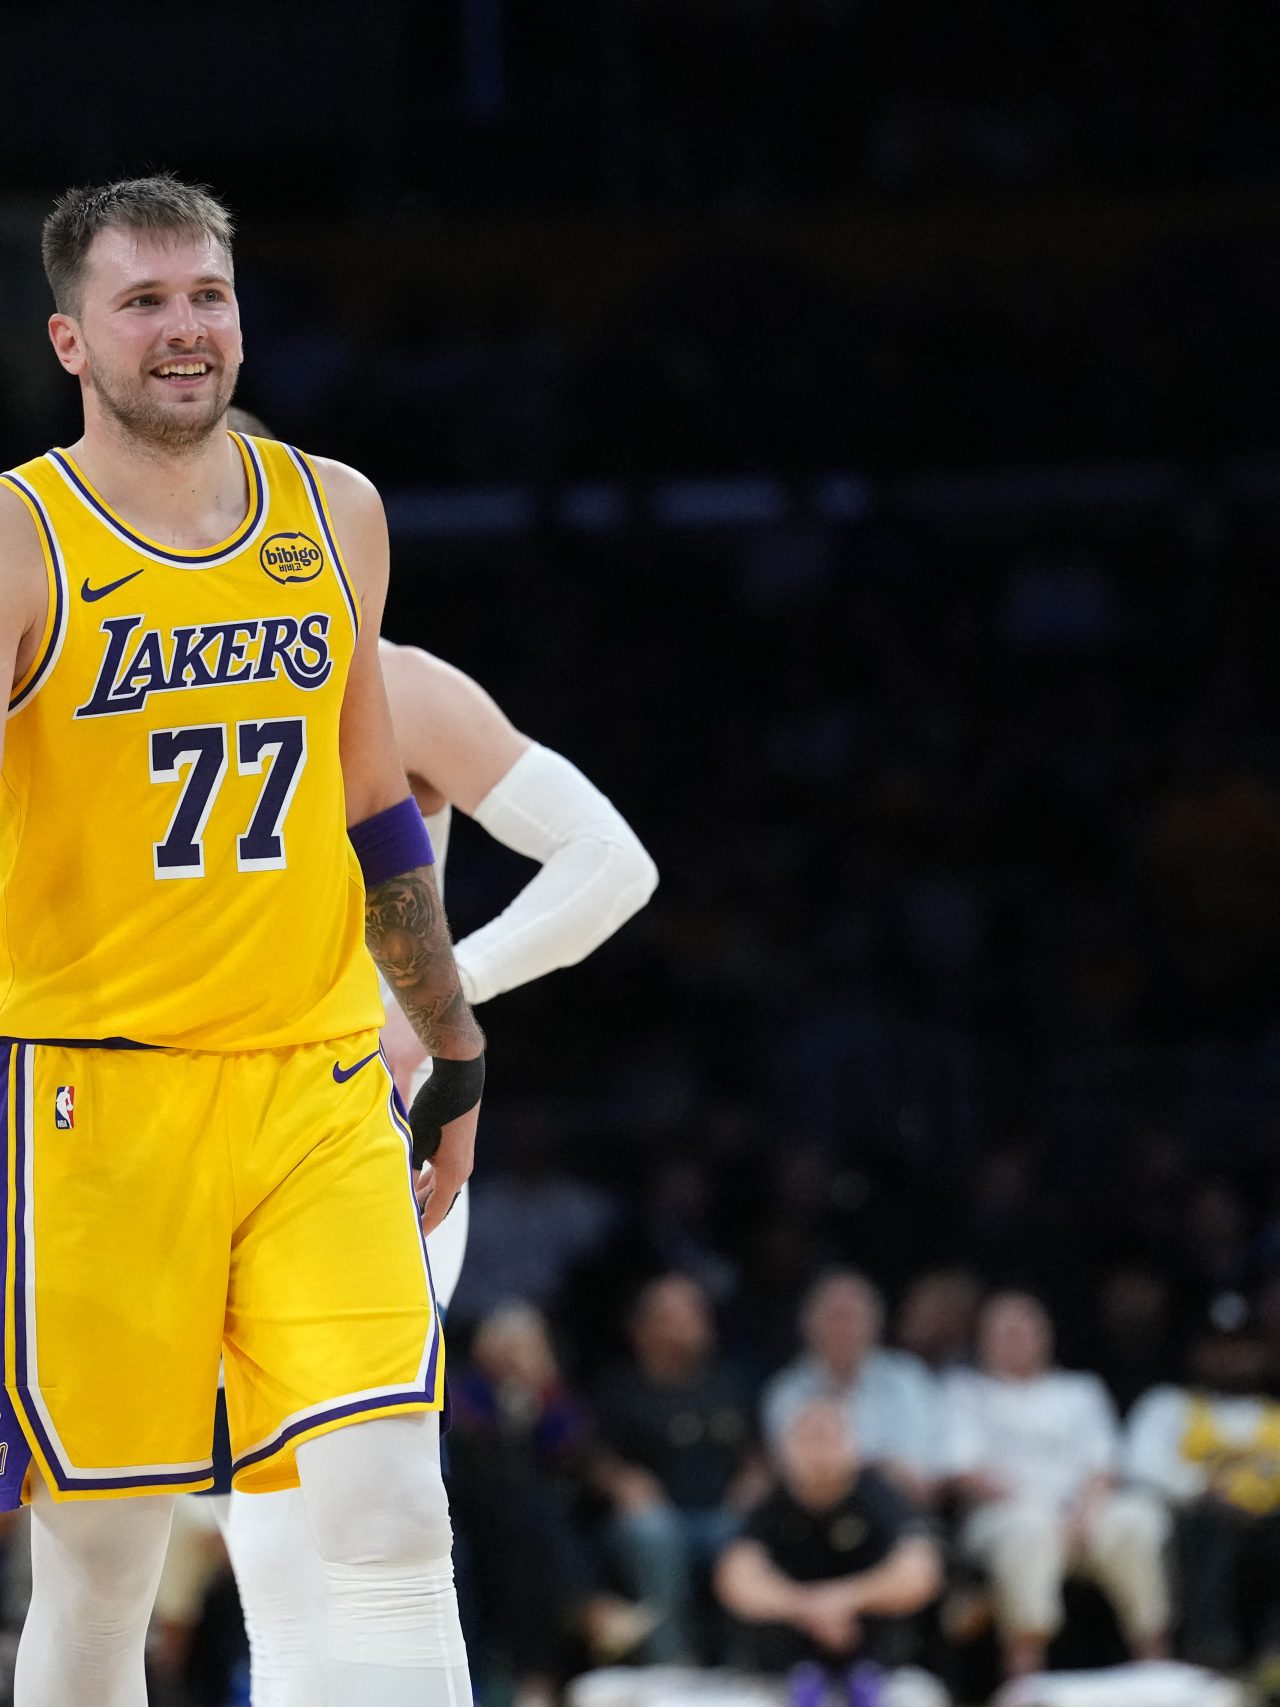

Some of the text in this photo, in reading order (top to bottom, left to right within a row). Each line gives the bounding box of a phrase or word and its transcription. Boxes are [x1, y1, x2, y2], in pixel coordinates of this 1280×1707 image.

[265, 545, 319, 566] bibigo
[279, 563, 302, 572] 비비고
[72, 612, 333, 720] LAKERS
[149, 716, 308, 880] 77
